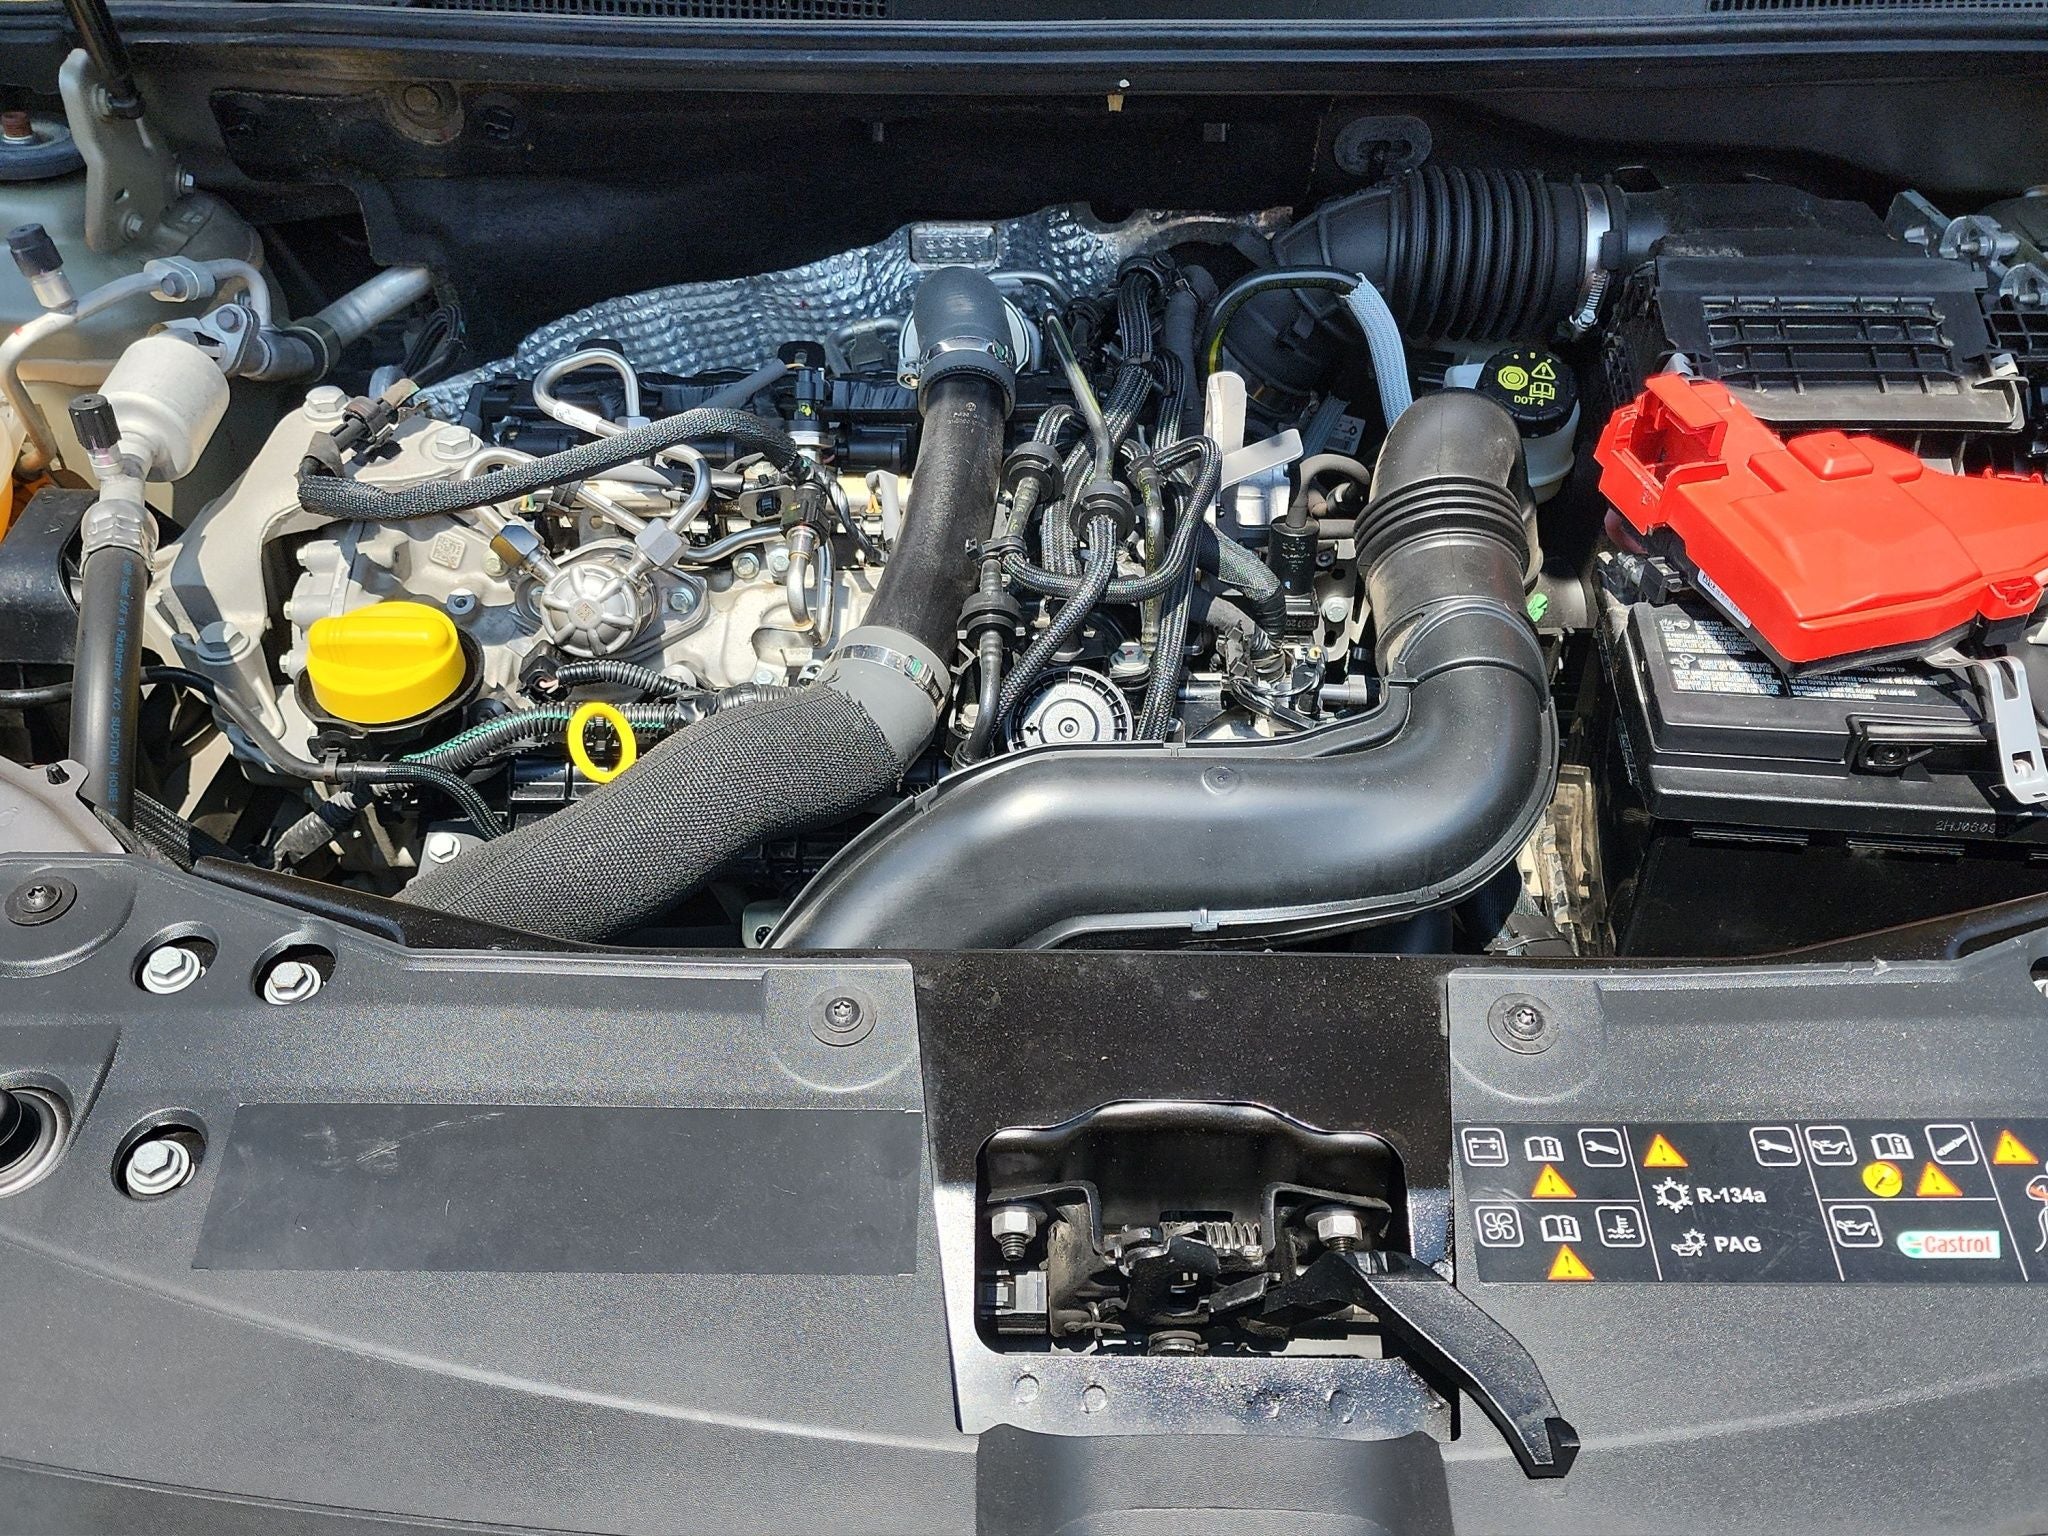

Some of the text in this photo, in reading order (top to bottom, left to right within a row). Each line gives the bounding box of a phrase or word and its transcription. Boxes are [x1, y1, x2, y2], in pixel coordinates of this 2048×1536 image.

[1514, 395, 1545, 407] DOT 4
[111, 687, 121, 710] A/C
[109, 716, 121, 765] SUCTION
[108, 771, 119, 801] HOSE
[1696, 1187, 1767, 1203] R-134a
[1713, 1236, 1762, 1252] PAG
[1925, 1236, 1992, 1253] Castrol
